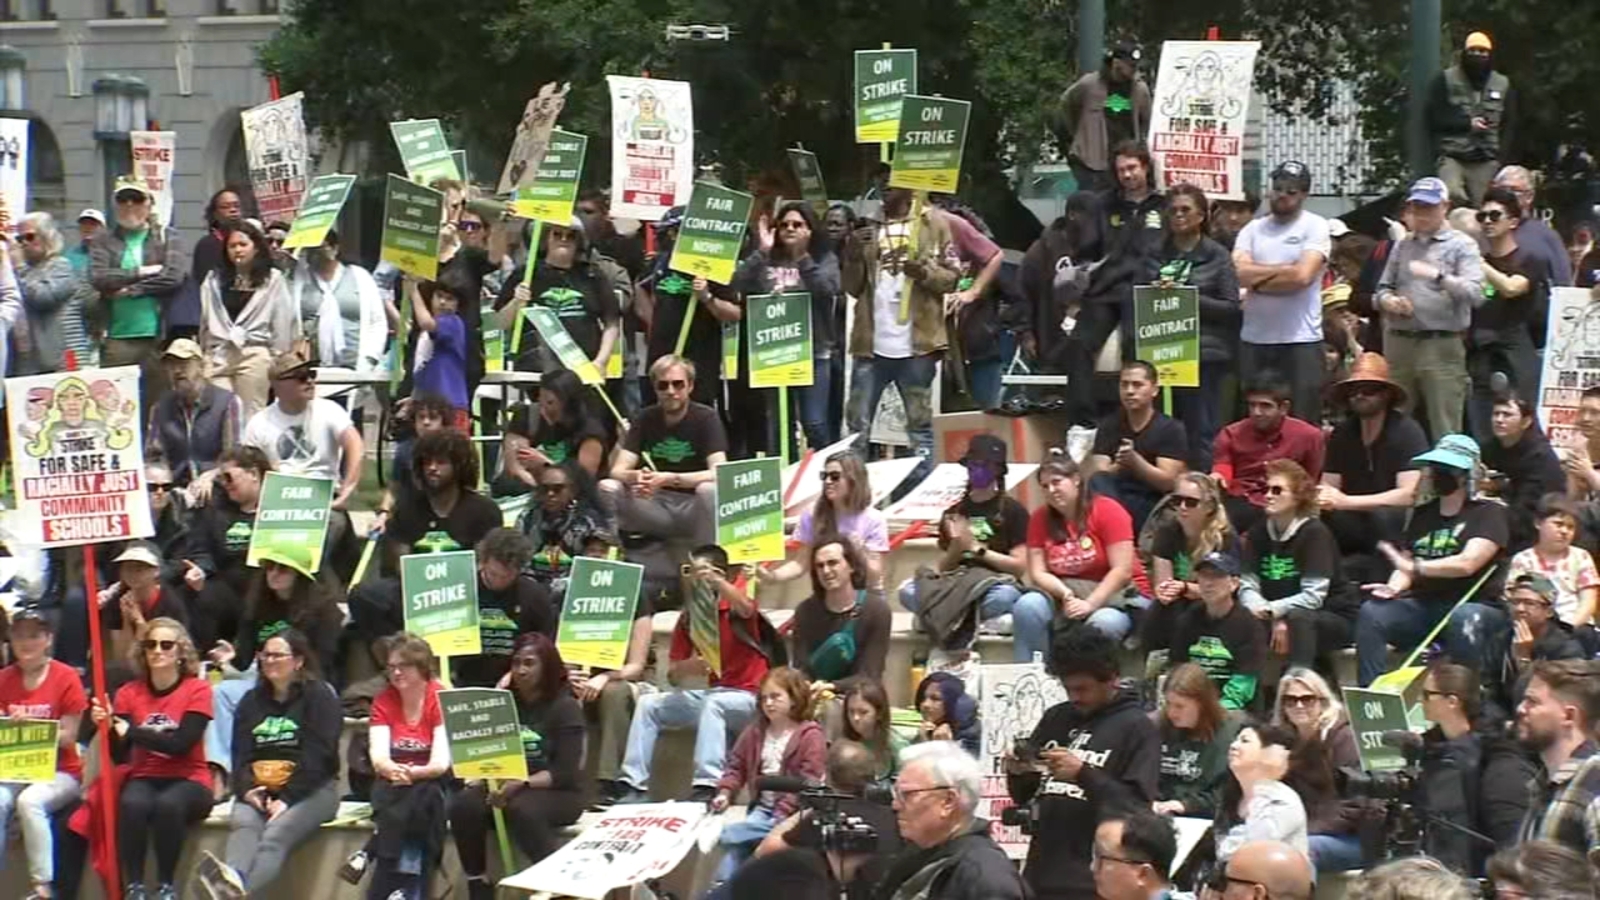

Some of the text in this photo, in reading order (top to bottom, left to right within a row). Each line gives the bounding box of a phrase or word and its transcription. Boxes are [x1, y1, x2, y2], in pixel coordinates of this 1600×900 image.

[873, 58, 893, 75] ON
[862, 78, 907, 100] STRIKE
[921, 106, 943, 121] ON
[1169, 117, 1191, 133] FOR
[1194, 119, 1217, 135] SAFE
[904, 129, 956, 146] STRIKE
[134, 147, 171, 162] STRIKE
[705, 197, 734, 212] FAIR
[685, 217, 744, 234] CONTRACT
[766, 302, 787, 319] ON
[1153, 297, 1180, 313] FAIR
[756, 322, 802, 345] STRIKE
[1139, 317, 1195, 339] CONTRACT
[60, 438, 96, 454] STRIKE
[39, 453, 121, 476] FOR SAFE &
[26, 471, 138, 497] RACIALLY JUST
[734, 469, 763, 489] FAIR
[281, 486, 313, 500] FAIR
[41, 495, 127, 517] COMMUNITY
[719, 489, 780, 518] CONTRACT
[260, 508, 326, 522] CONTRACT
[49, 515, 123, 541] SCHOOLS
[733, 519, 767, 539] NOW!
[425, 562, 448, 581] ON
[590, 569, 614, 588] ON
[412, 583, 467, 611] STRIKE
[570, 596, 626, 614] STRIKE
[470, 713, 491, 723] AND
[1364, 701, 1385, 720] ON
[452, 727, 493, 741] RACIALLY
[600, 816, 689, 833] STRIKE
[573, 840, 646, 855] CONTRACT
